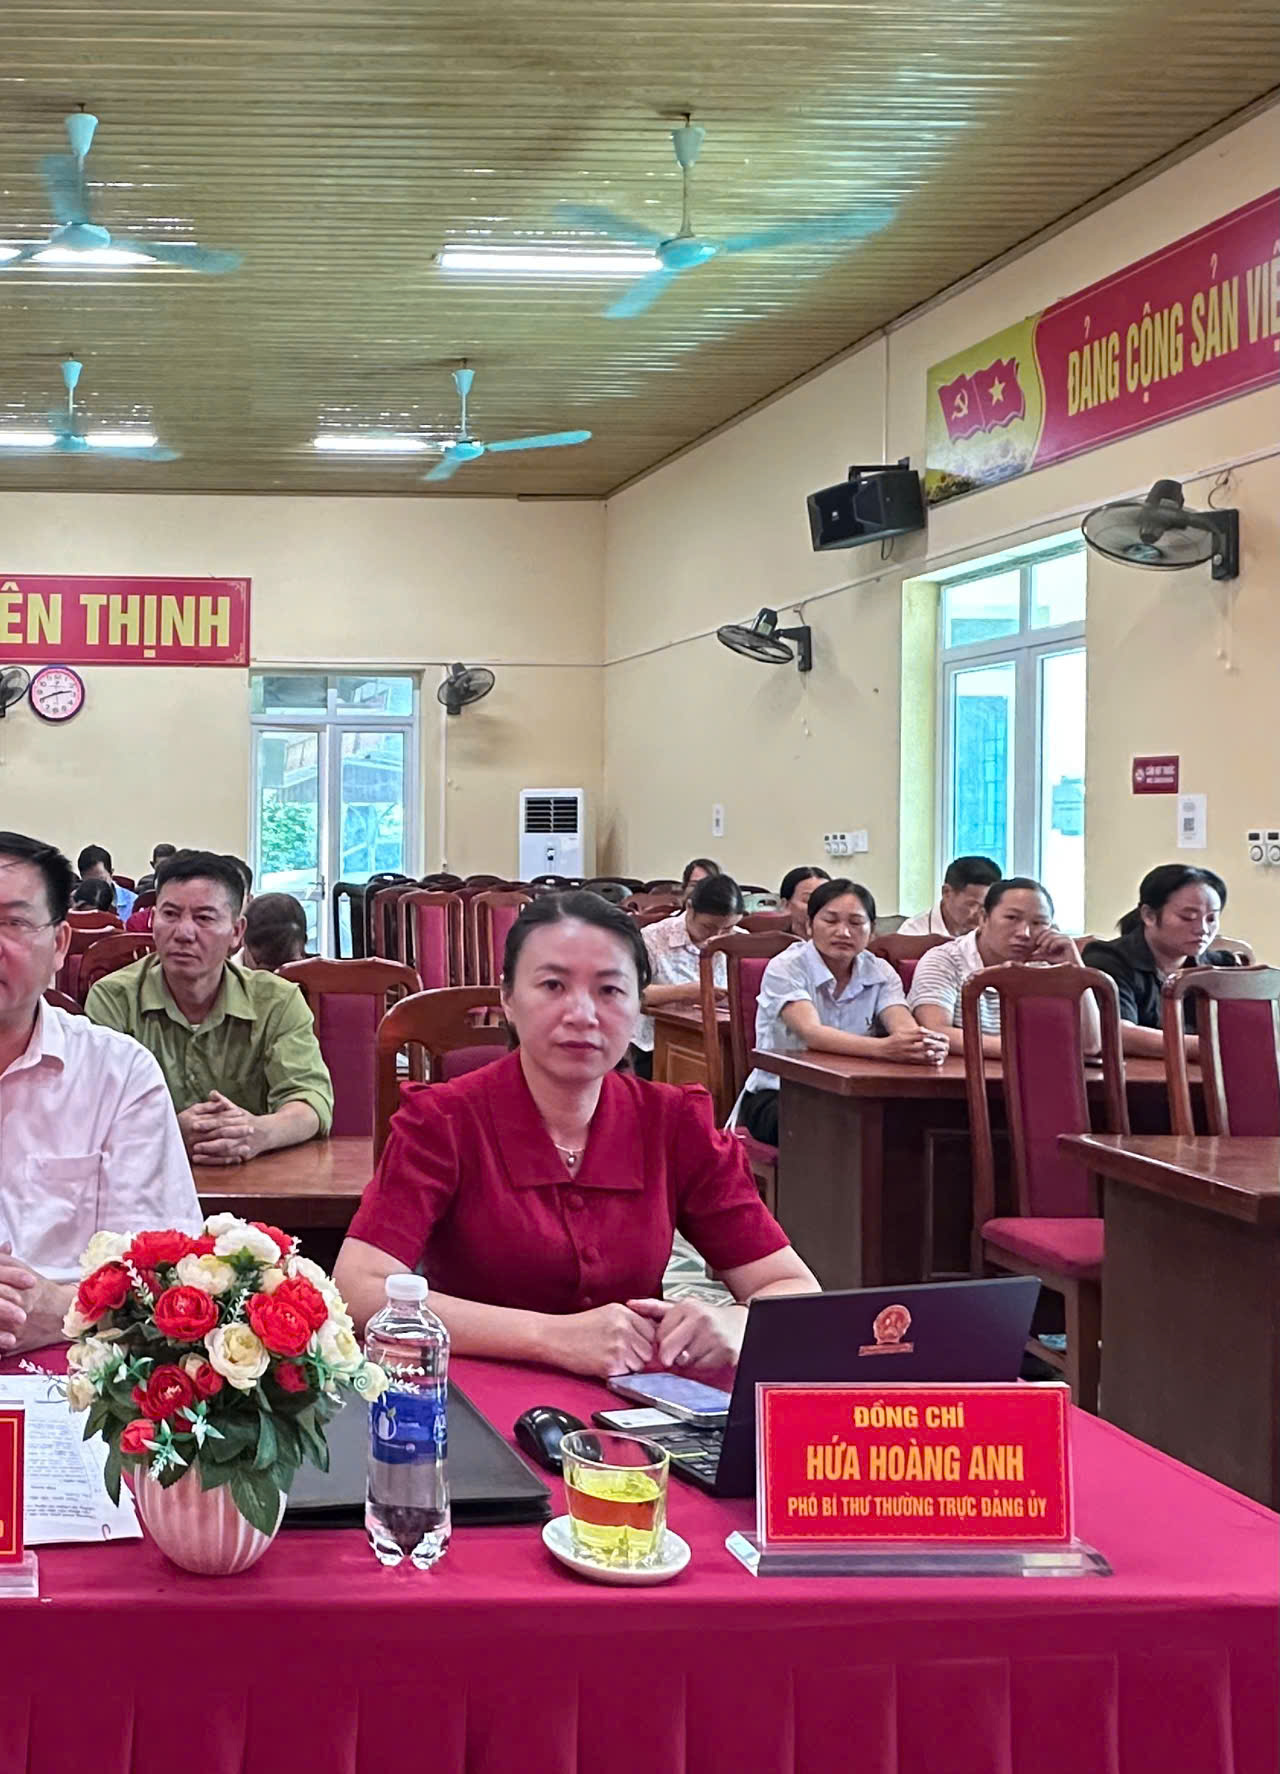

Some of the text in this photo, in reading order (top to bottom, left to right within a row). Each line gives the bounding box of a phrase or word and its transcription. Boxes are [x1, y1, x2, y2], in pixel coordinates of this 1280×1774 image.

[1067, 314, 1121, 417] ĐẢNG
[1125, 302, 1184, 405] CỘNG
[1190, 252, 1240, 368] SẢN
[79, 593, 231, 659] THỊNH
[853, 1399, 965, 1429] ĐỒNG CHÍ
[806, 1434, 1025, 1482] HỨA HOÀNG ANH
[787, 1489, 1048, 1520] PHÓ BÍ THƯ THƯỜNG TRỰC ĐẢNG ỦY
